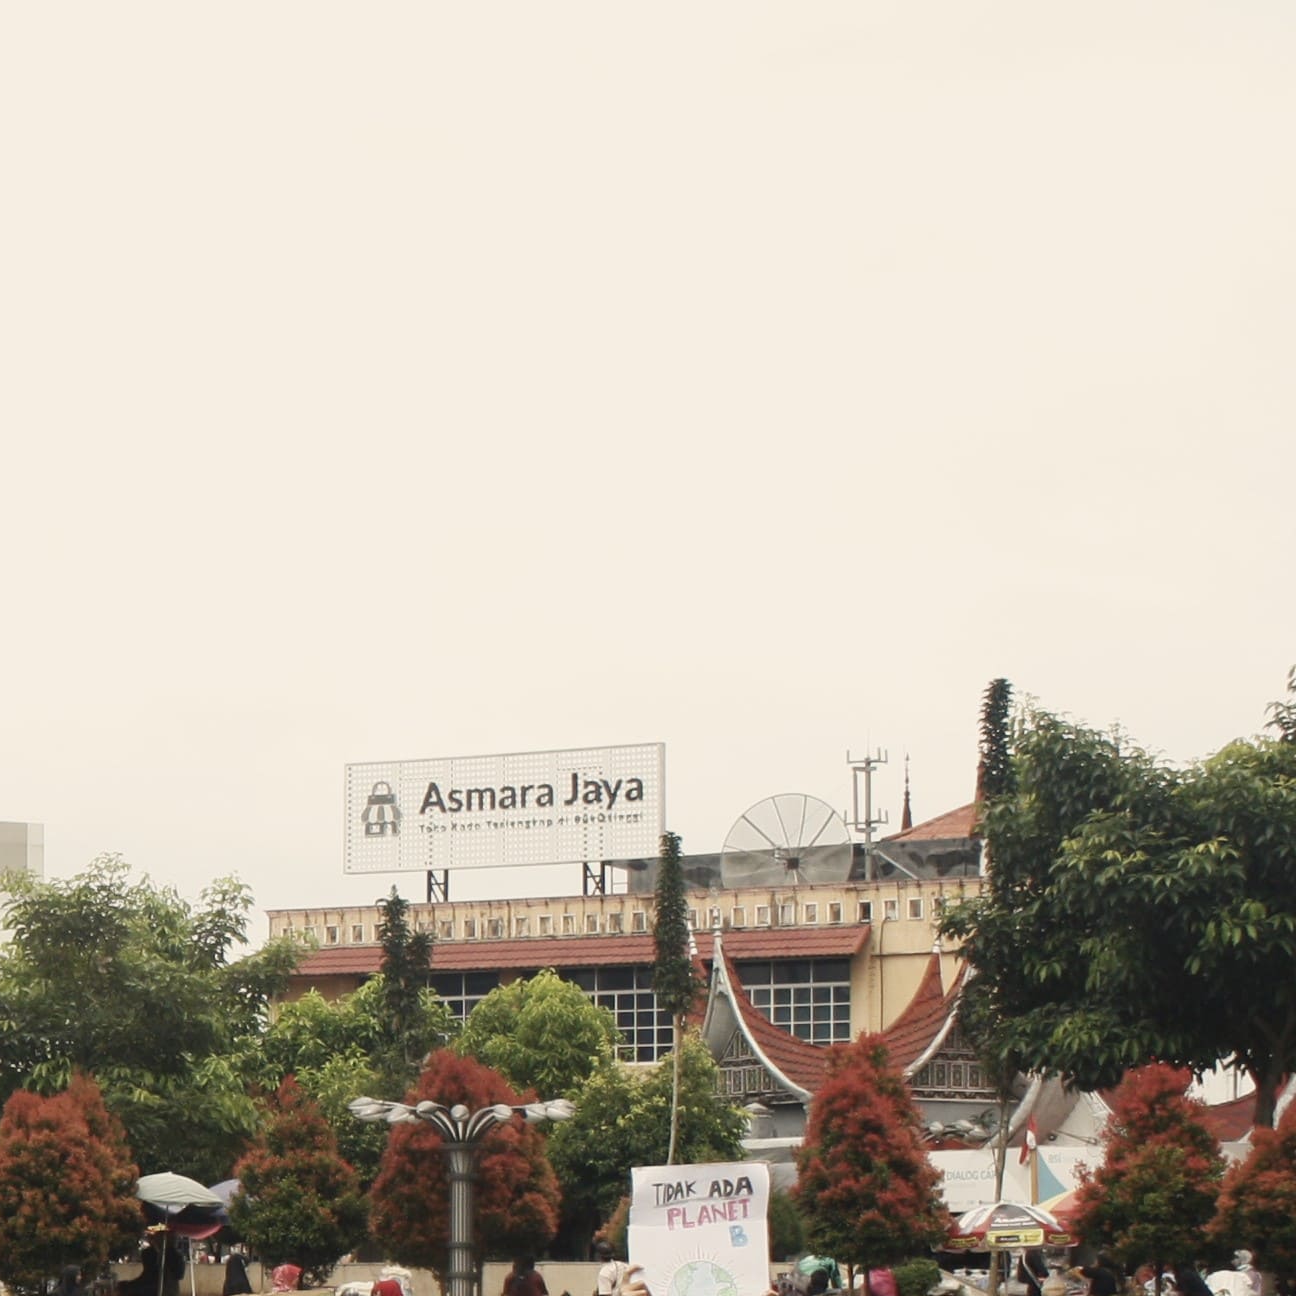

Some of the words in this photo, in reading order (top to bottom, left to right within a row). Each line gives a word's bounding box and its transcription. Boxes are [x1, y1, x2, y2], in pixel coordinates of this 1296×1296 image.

[419, 781, 555, 815] Asmara
[563, 771, 645, 810] Jaya
[651, 1179, 698, 1207] TIDAK
[708, 1175, 754, 1199] ADA
[666, 1198, 751, 1231] PLANET
[729, 1224, 748, 1247] B
